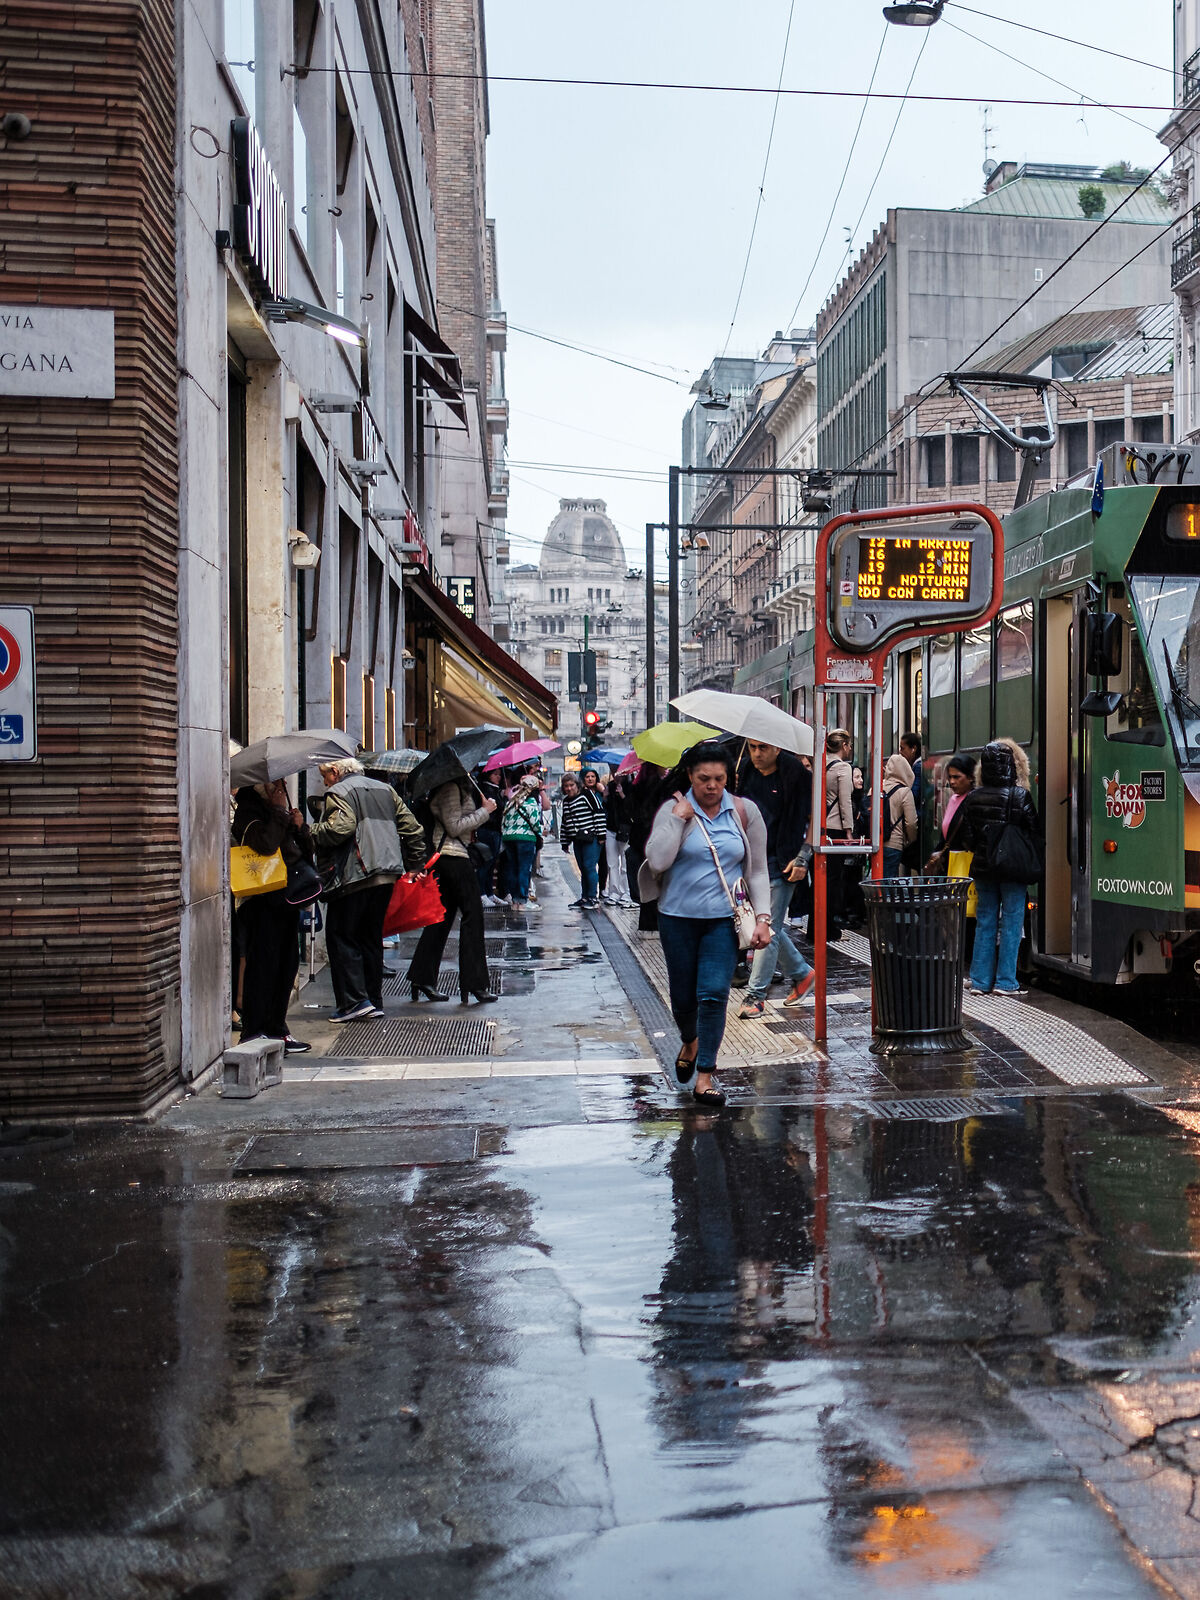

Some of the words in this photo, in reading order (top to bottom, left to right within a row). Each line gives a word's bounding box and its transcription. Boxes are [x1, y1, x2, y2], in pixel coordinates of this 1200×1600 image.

[248, 118, 288, 302] SPONTINI
[1, 316, 34, 328] VIA
[0, 353, 73, 373] GANA
[894, 538, 912, 549] IN
[868, 549, 886, 561] 16
[926, 550, 936, 562] 4
[942, 550, 970, 563] MIN
[868, 561, 885, 573] 19
[919, 562, 936, 574] 12
[942, 563, 969, 575] MIN
[858, 573, 883, 586] NM1
[900, 574, 969, 588] NOTTURNA
[451, 578, 471, 605] T
[887, 587, 914, 599] CON
[921, 588, 965, 600] CARTA
[1143, 777, 1163, 786] FACTORY
[1120, 783, 1143, 801] FOX
[1143, 786, 1163, 795] STORES
[1106, 800, 1145, 817] TOWN
[1097, 878, 1174, 896] FOXTOWN.COM
